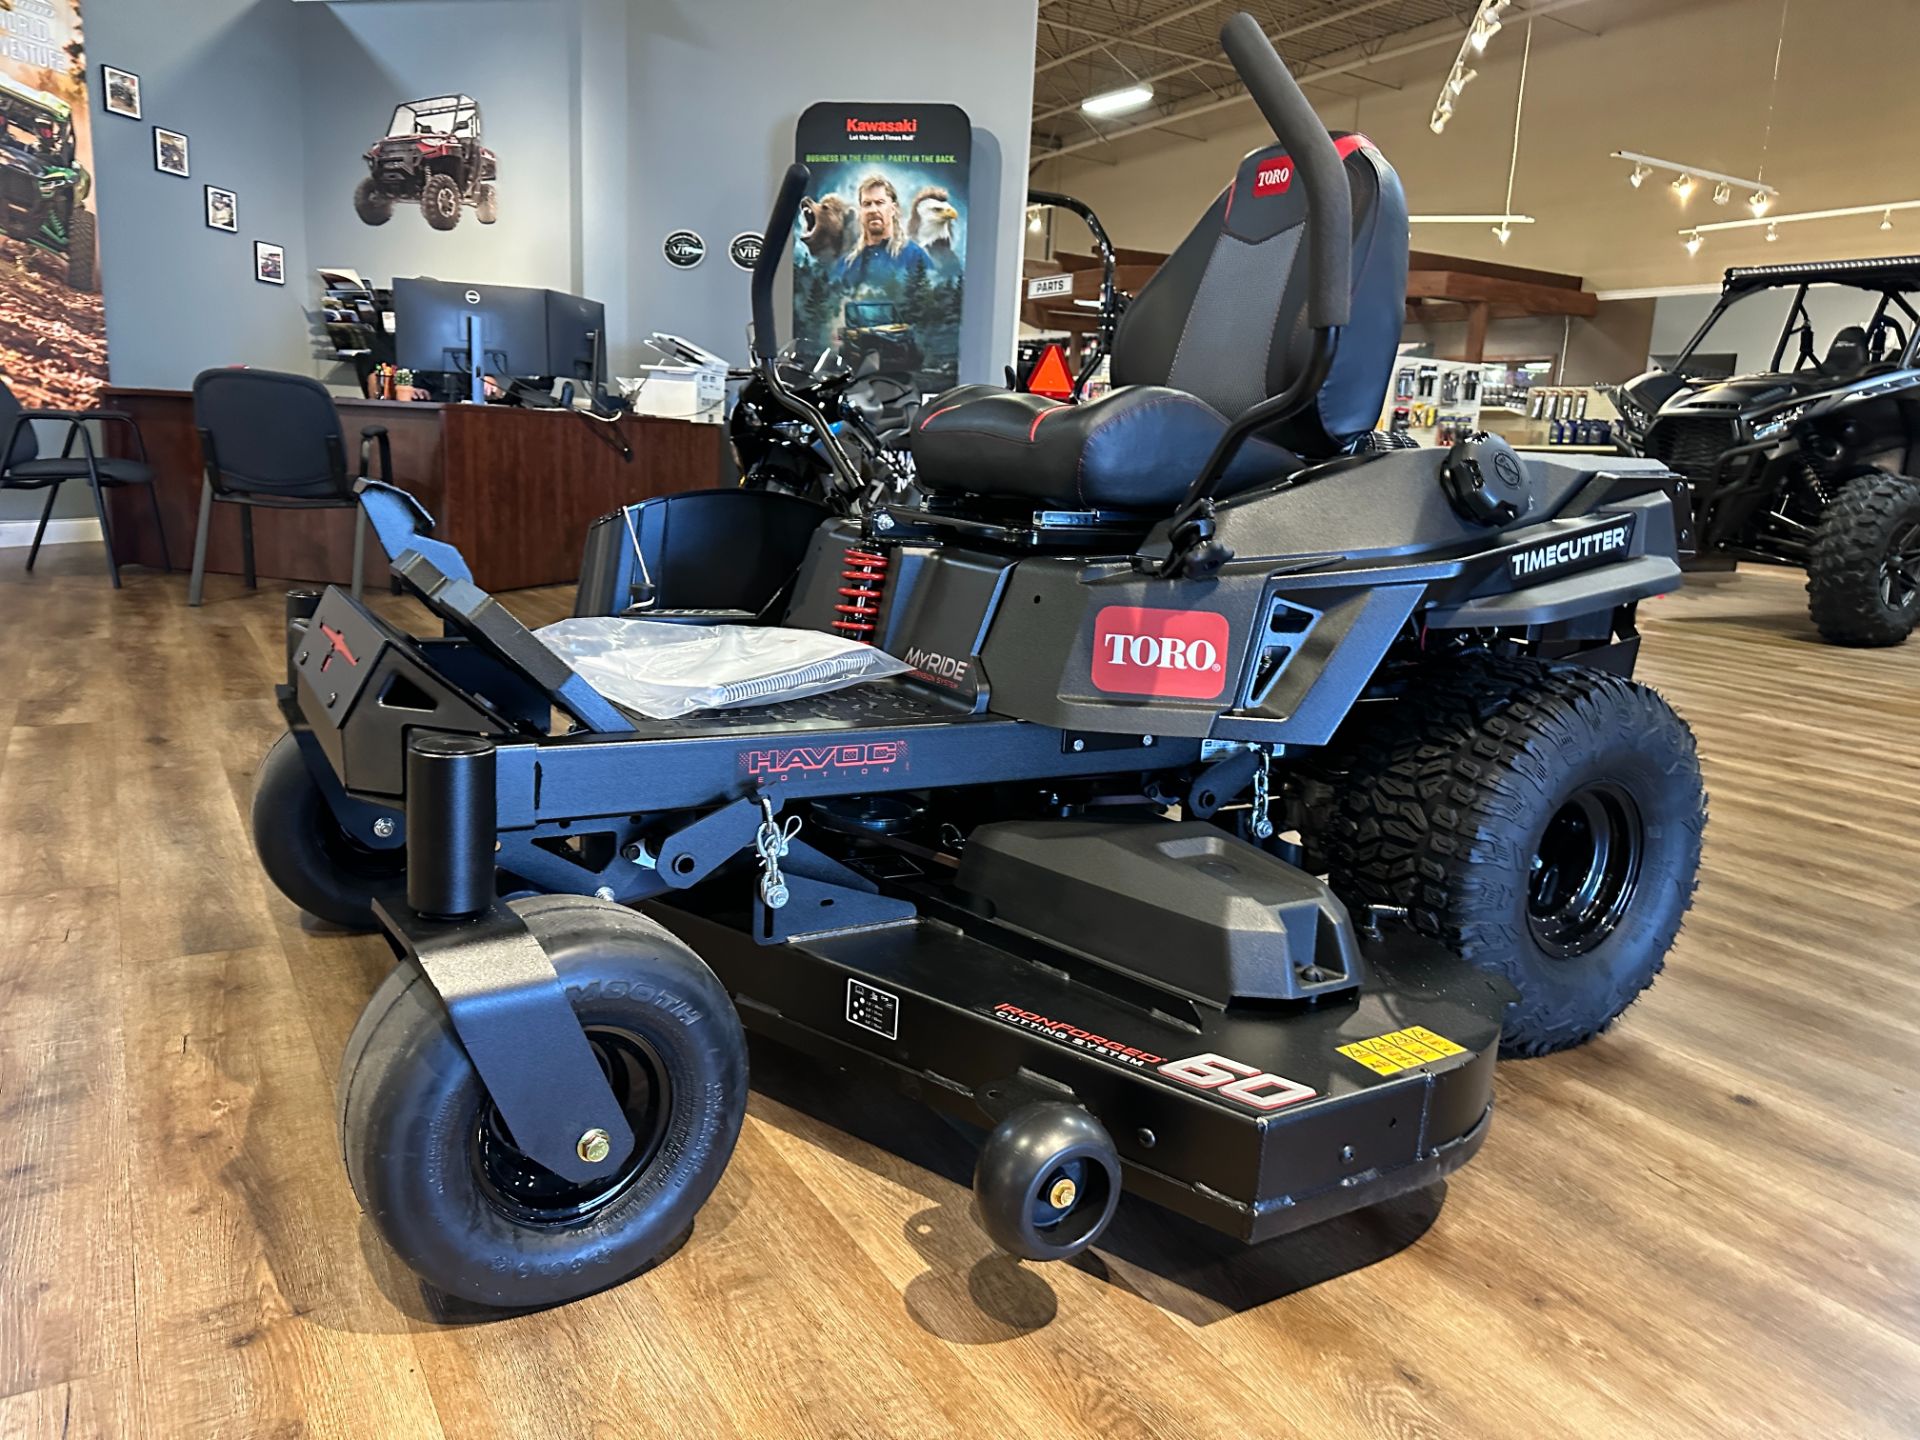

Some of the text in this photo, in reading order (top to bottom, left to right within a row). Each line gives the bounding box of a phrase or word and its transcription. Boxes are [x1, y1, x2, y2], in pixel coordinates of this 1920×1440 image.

[847, 119, 917, 132] Kawasaki
[885, 134, 901, 142] Times
[806, 154, 839, 163] BUSINESS
[840, 154, 848, 163] IN
[849, 154, 861, 163] THE
[888, 154, 910, 163] PARTY
[912, 154, 920, 163] IN
[921, 154, 934, 163] THE
[1258, 167, 1290, 187] TORO
[1036, 280, 1064, 292] PARTS
[1512, 527, 1625, 576] TIMECUTTER
[1104, 633, 1217, 671] TORO
[749, 742, 897, 774] HAVOC
[758, 767, 890, 783] EDITION
[565, 979, 703, 1026] MOOTH
[995, 1011, 1145, 1067] CUTTING SYSTEM
[1157, 1053, 1317, 1110] 60
